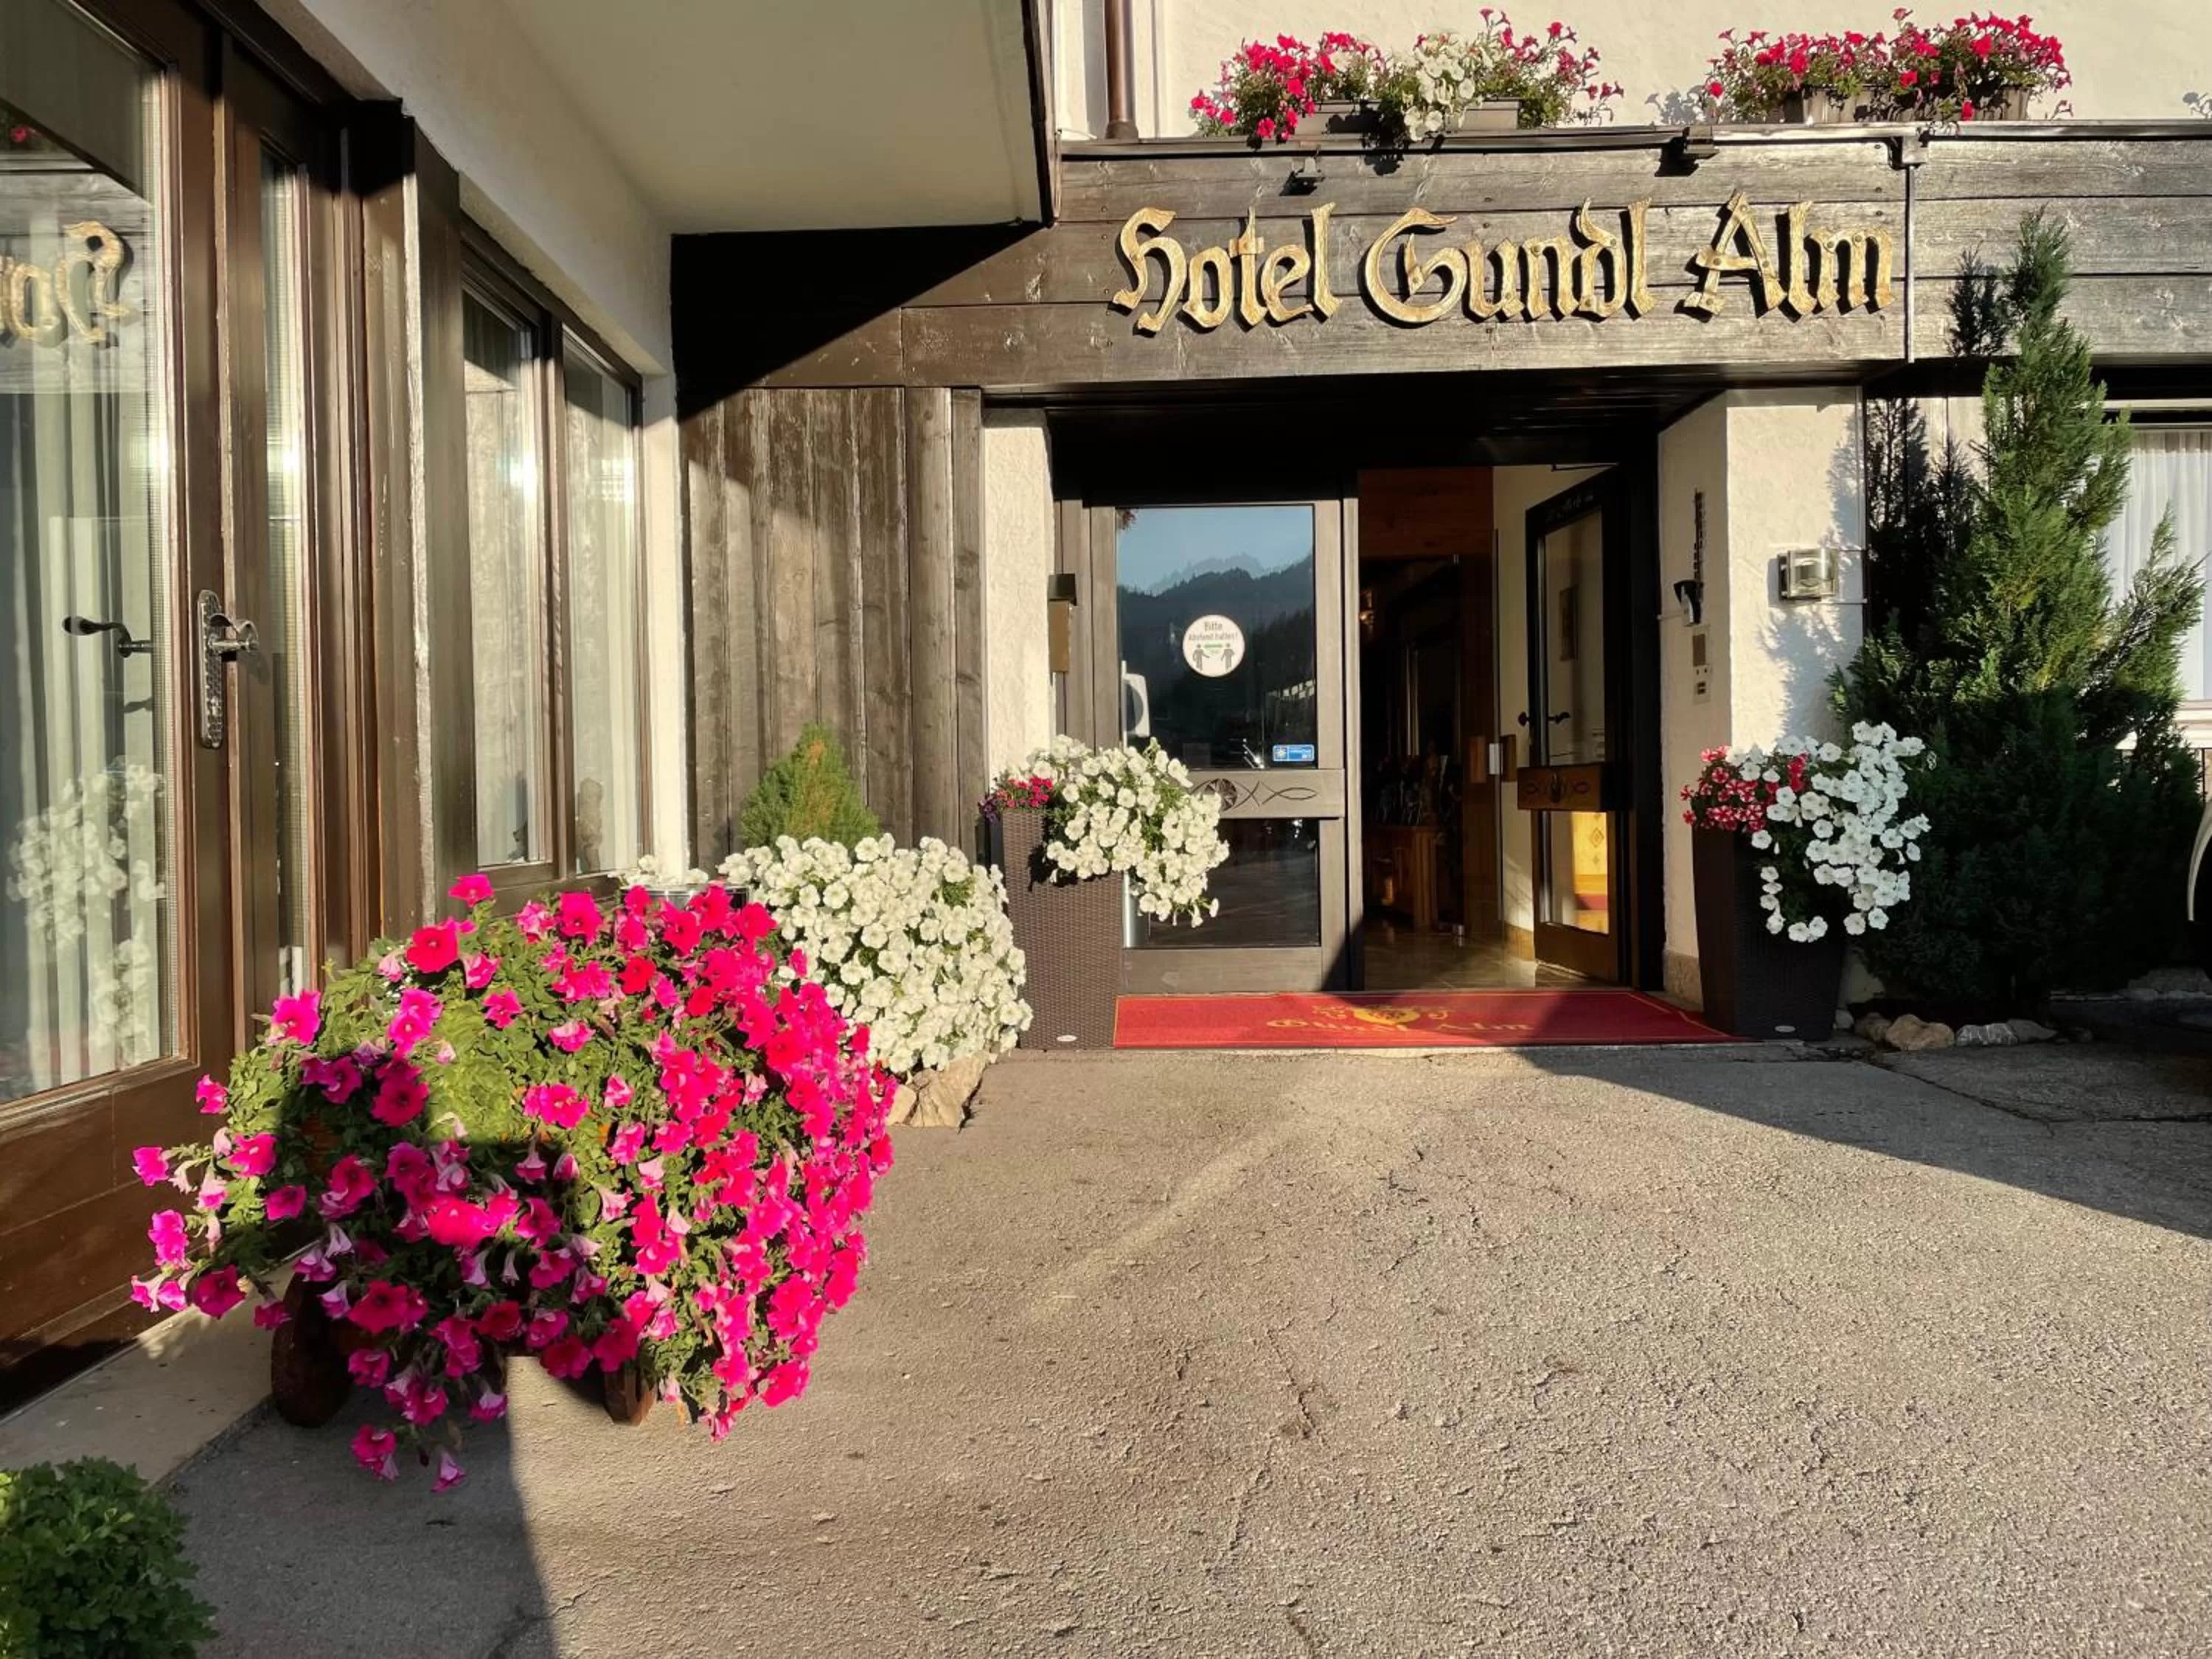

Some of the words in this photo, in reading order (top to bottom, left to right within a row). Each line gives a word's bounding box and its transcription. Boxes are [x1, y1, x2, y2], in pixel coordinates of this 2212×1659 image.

[1113, 202, 1343, 331] Hotel
[1364, 198, 1653, 324] Gundl
[1682, 189, 1893, 318] Alm
